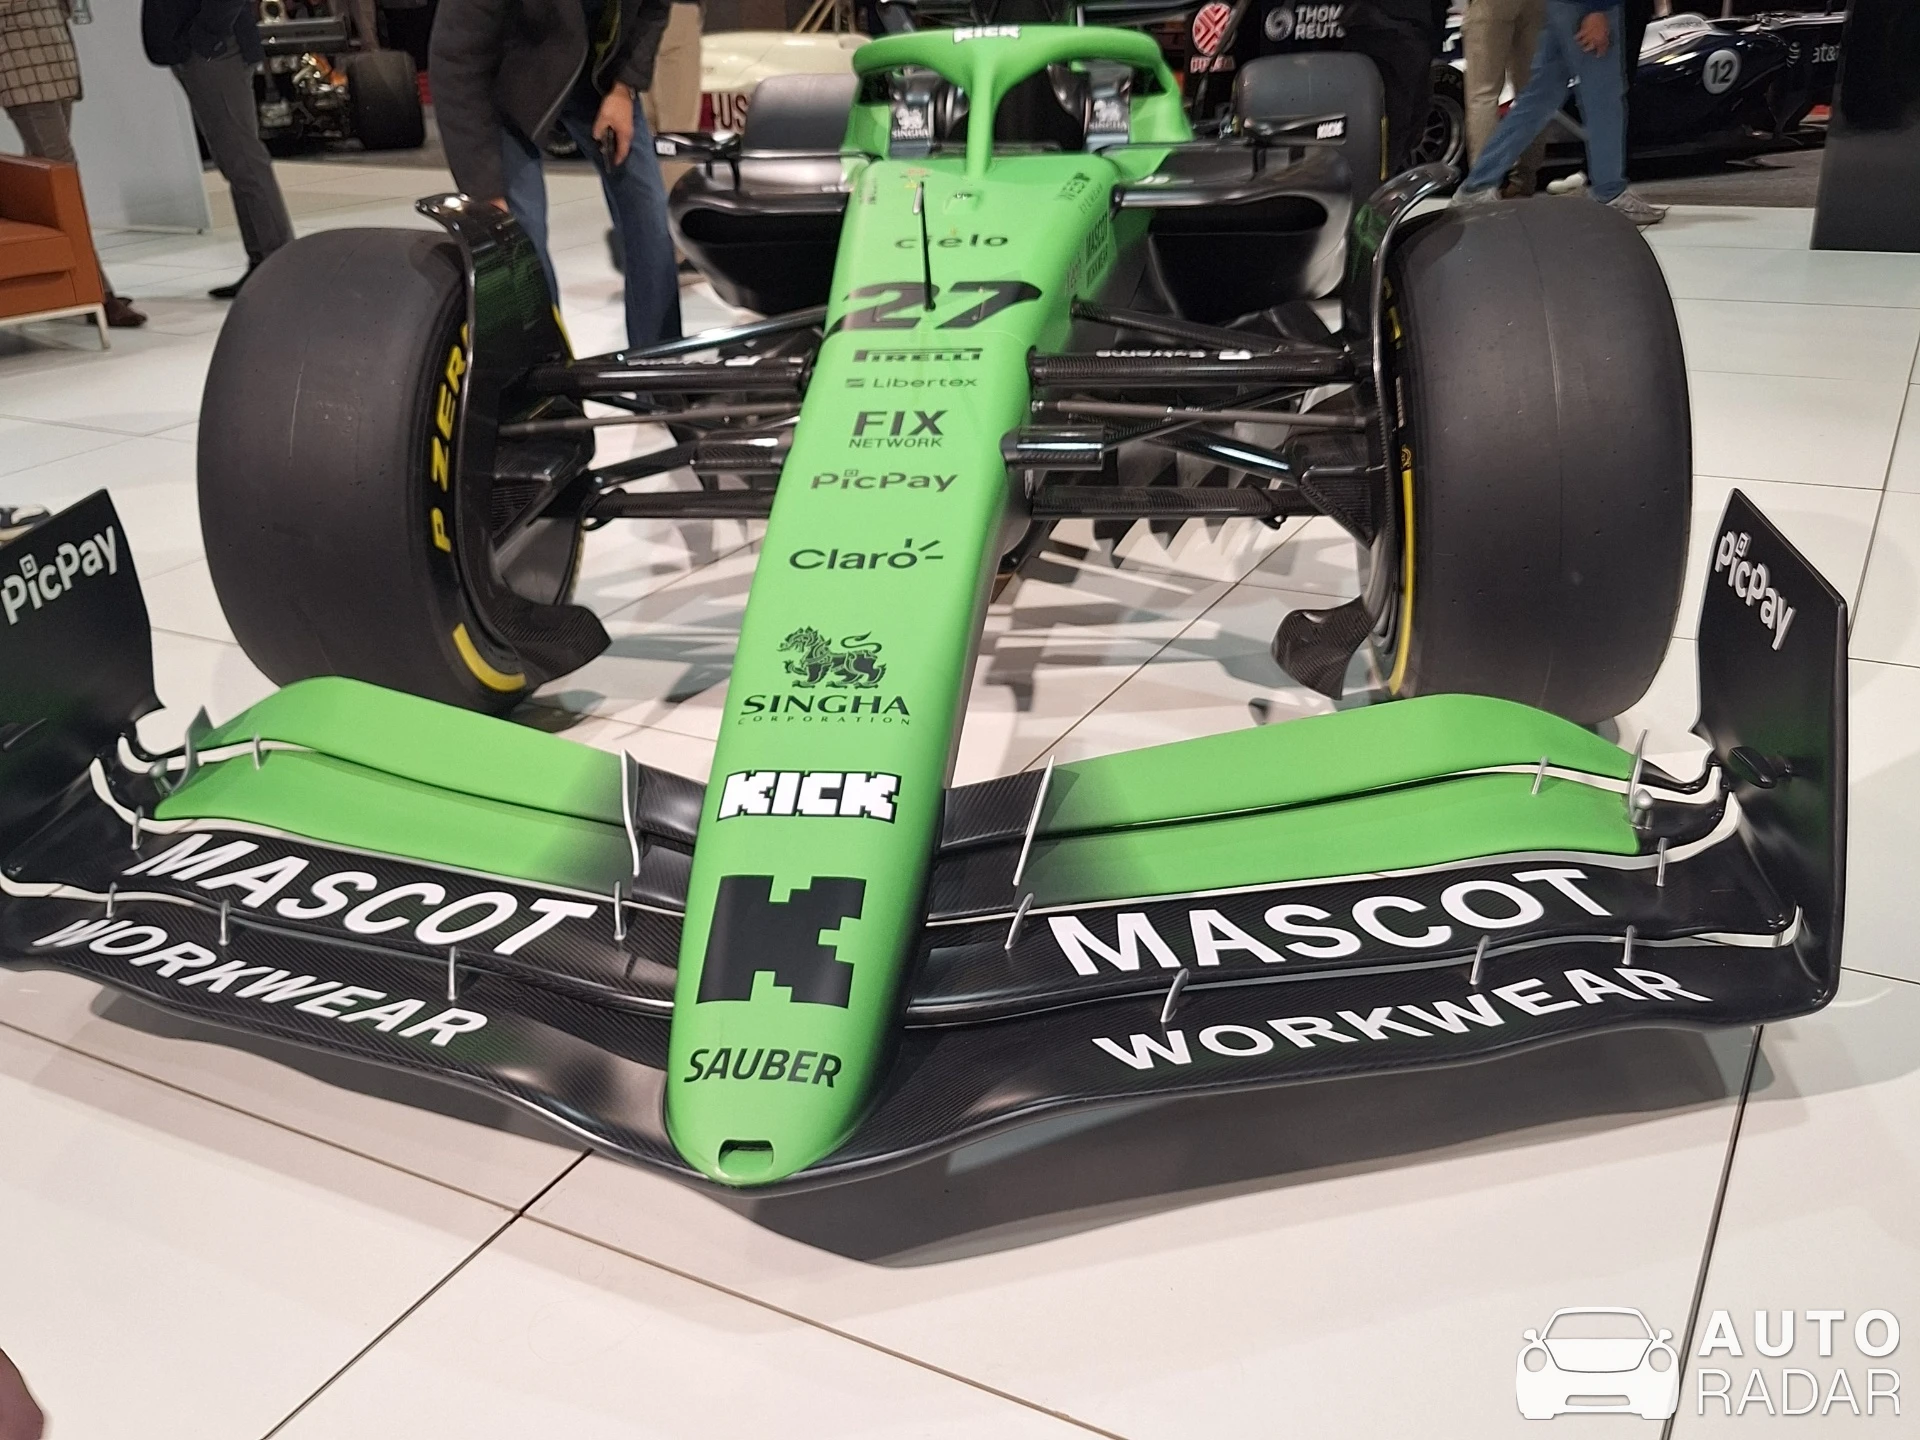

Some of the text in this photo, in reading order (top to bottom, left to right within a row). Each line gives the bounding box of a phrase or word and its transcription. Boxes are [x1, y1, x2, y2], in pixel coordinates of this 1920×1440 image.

[1709, 60, 1735, 85] 12
[822, 280, 1042, 344] 27
[852, 348, 984, 363] PIRELLI
[873, 378, 978, 388] Libertex
[848, 438, 943, 449] NETWORK
[852, 410, 949, 437] FIX
[810, 470, 959, 493] PicPay
[430, 507, 452, 553] P
[0, 525, 118, 626] PicPay
[789, 541, 933, 570] Claro
[1714, 531, 1797, 651] PicPay
[738, 715, 911, 726] CORPORATION
[740, 694, 911, 716] SINGHA
[717, 769, 902, 824] KICK
[122, 833, 598, 956] MASCOT
[696, 874, 867, 1009] K
[1047, 868, 1613, 977] MASCOT
[32, 919, 488, 1048] WORKWEAR
[1092, 966, 1713, 1070] WORKWEAR
[684, 1047, 842, 1088] SAUBER
